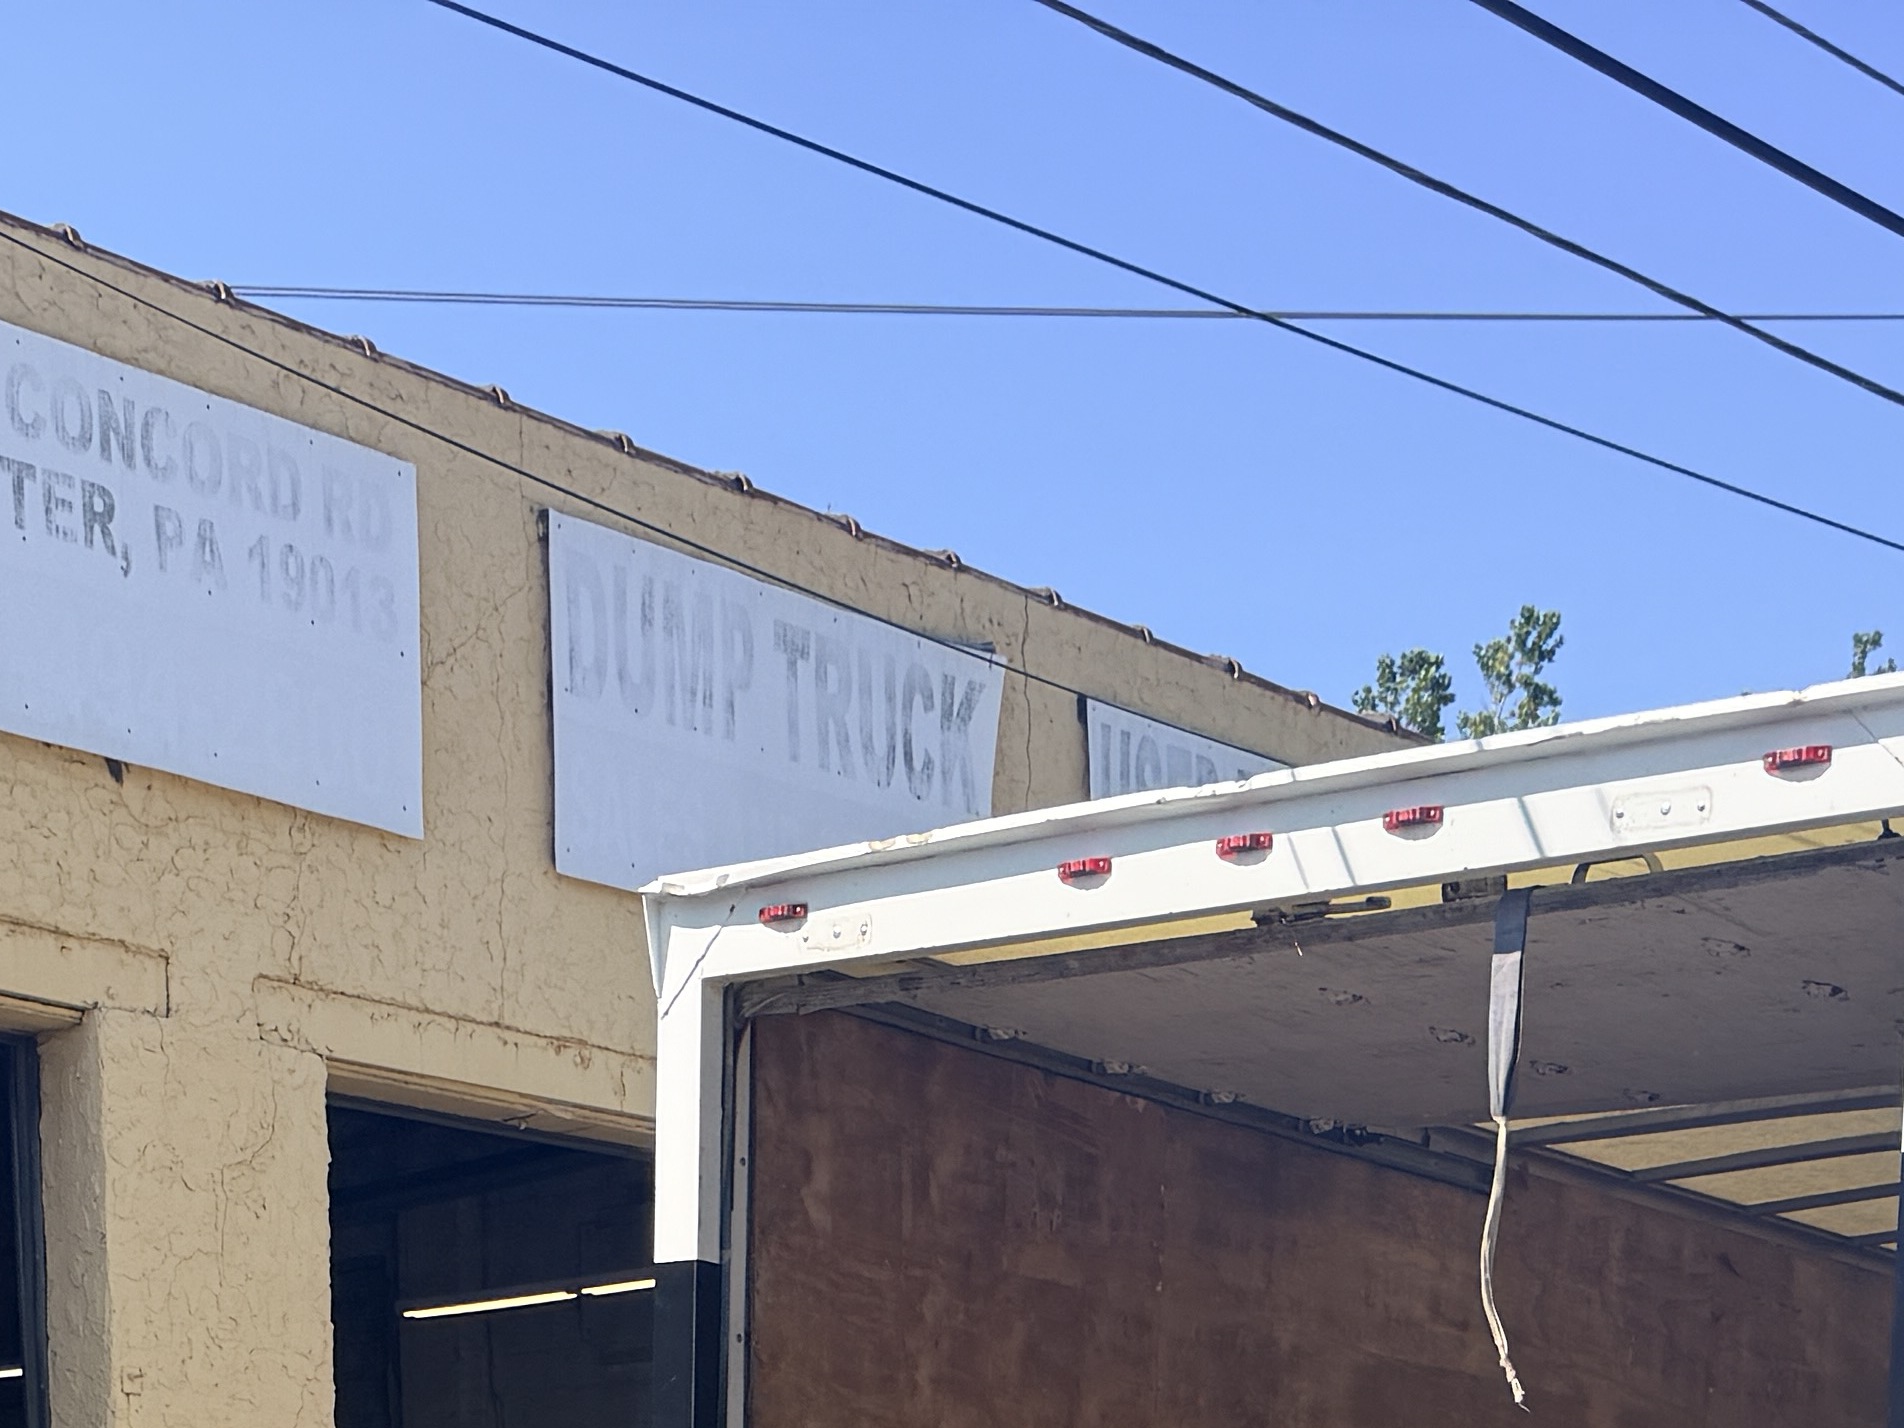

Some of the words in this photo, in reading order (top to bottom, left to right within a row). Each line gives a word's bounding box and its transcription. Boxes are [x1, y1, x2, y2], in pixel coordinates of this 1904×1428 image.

[5, 360, 302, 523] CONCORD
[152, 503, 229, 593] PA
[564, 548, 756, 741] DUMP
[773, 618, 987, 816] TRUCK
